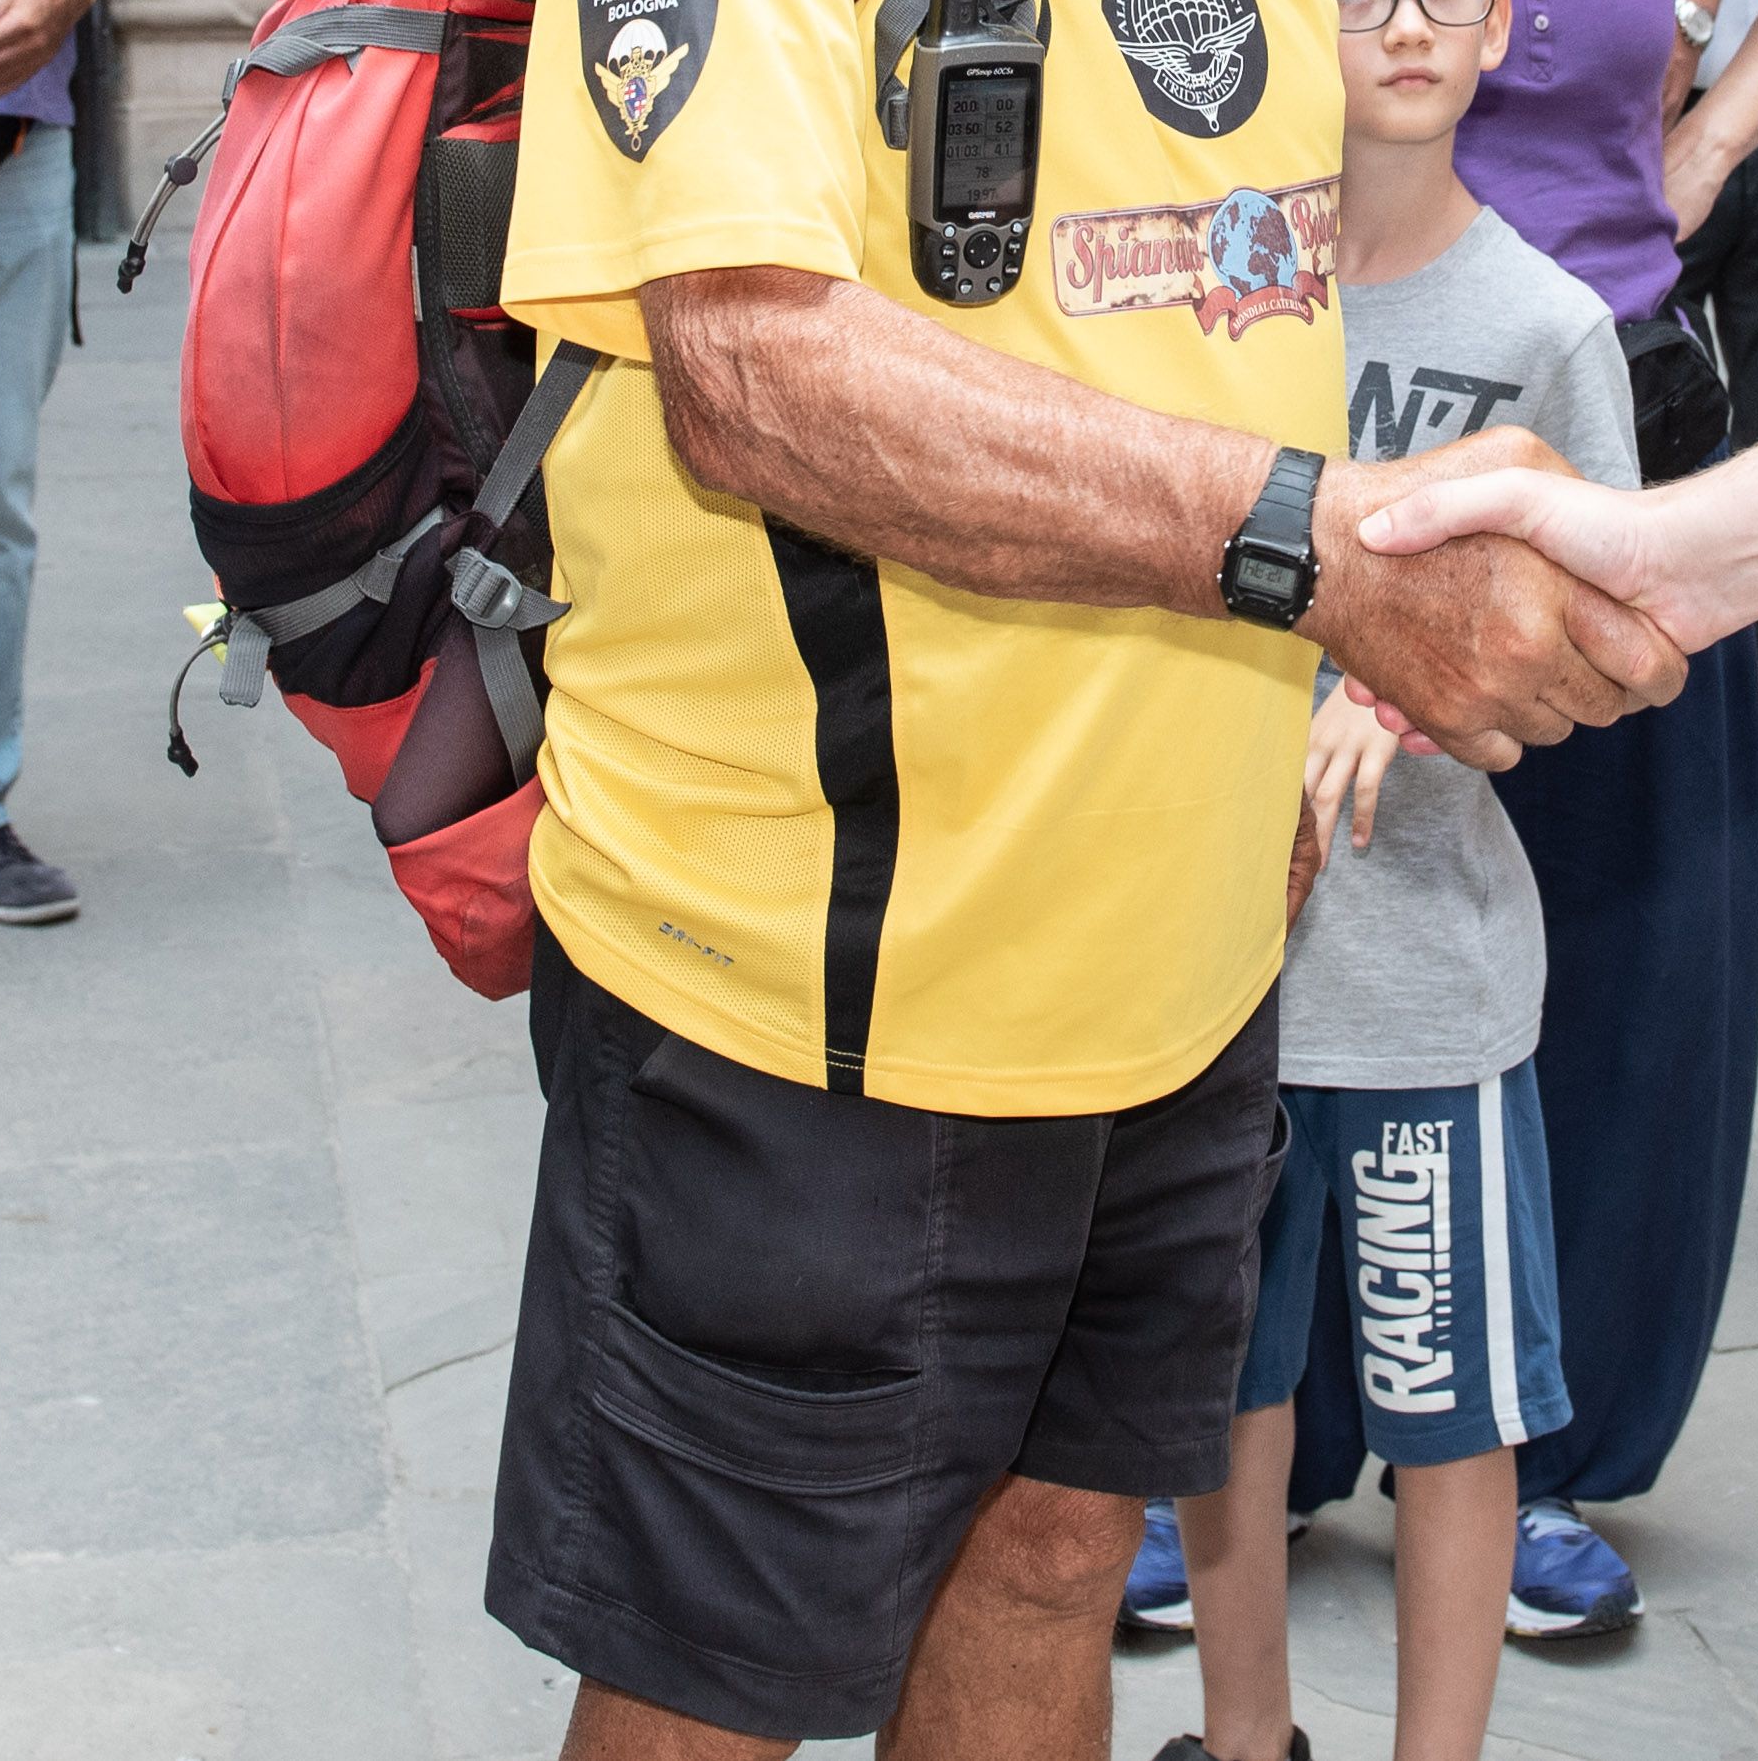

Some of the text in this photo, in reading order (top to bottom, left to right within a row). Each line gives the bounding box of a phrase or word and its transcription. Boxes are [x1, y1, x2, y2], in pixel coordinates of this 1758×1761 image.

[1161, 66, 1239, 105] TRIDENTINA
[1233, 298, 1309, 333] MONDIAL CATERING
[1382, 1120, 1454, 1155] FAST
[1351, 1149, 1456, 1414] RACING
